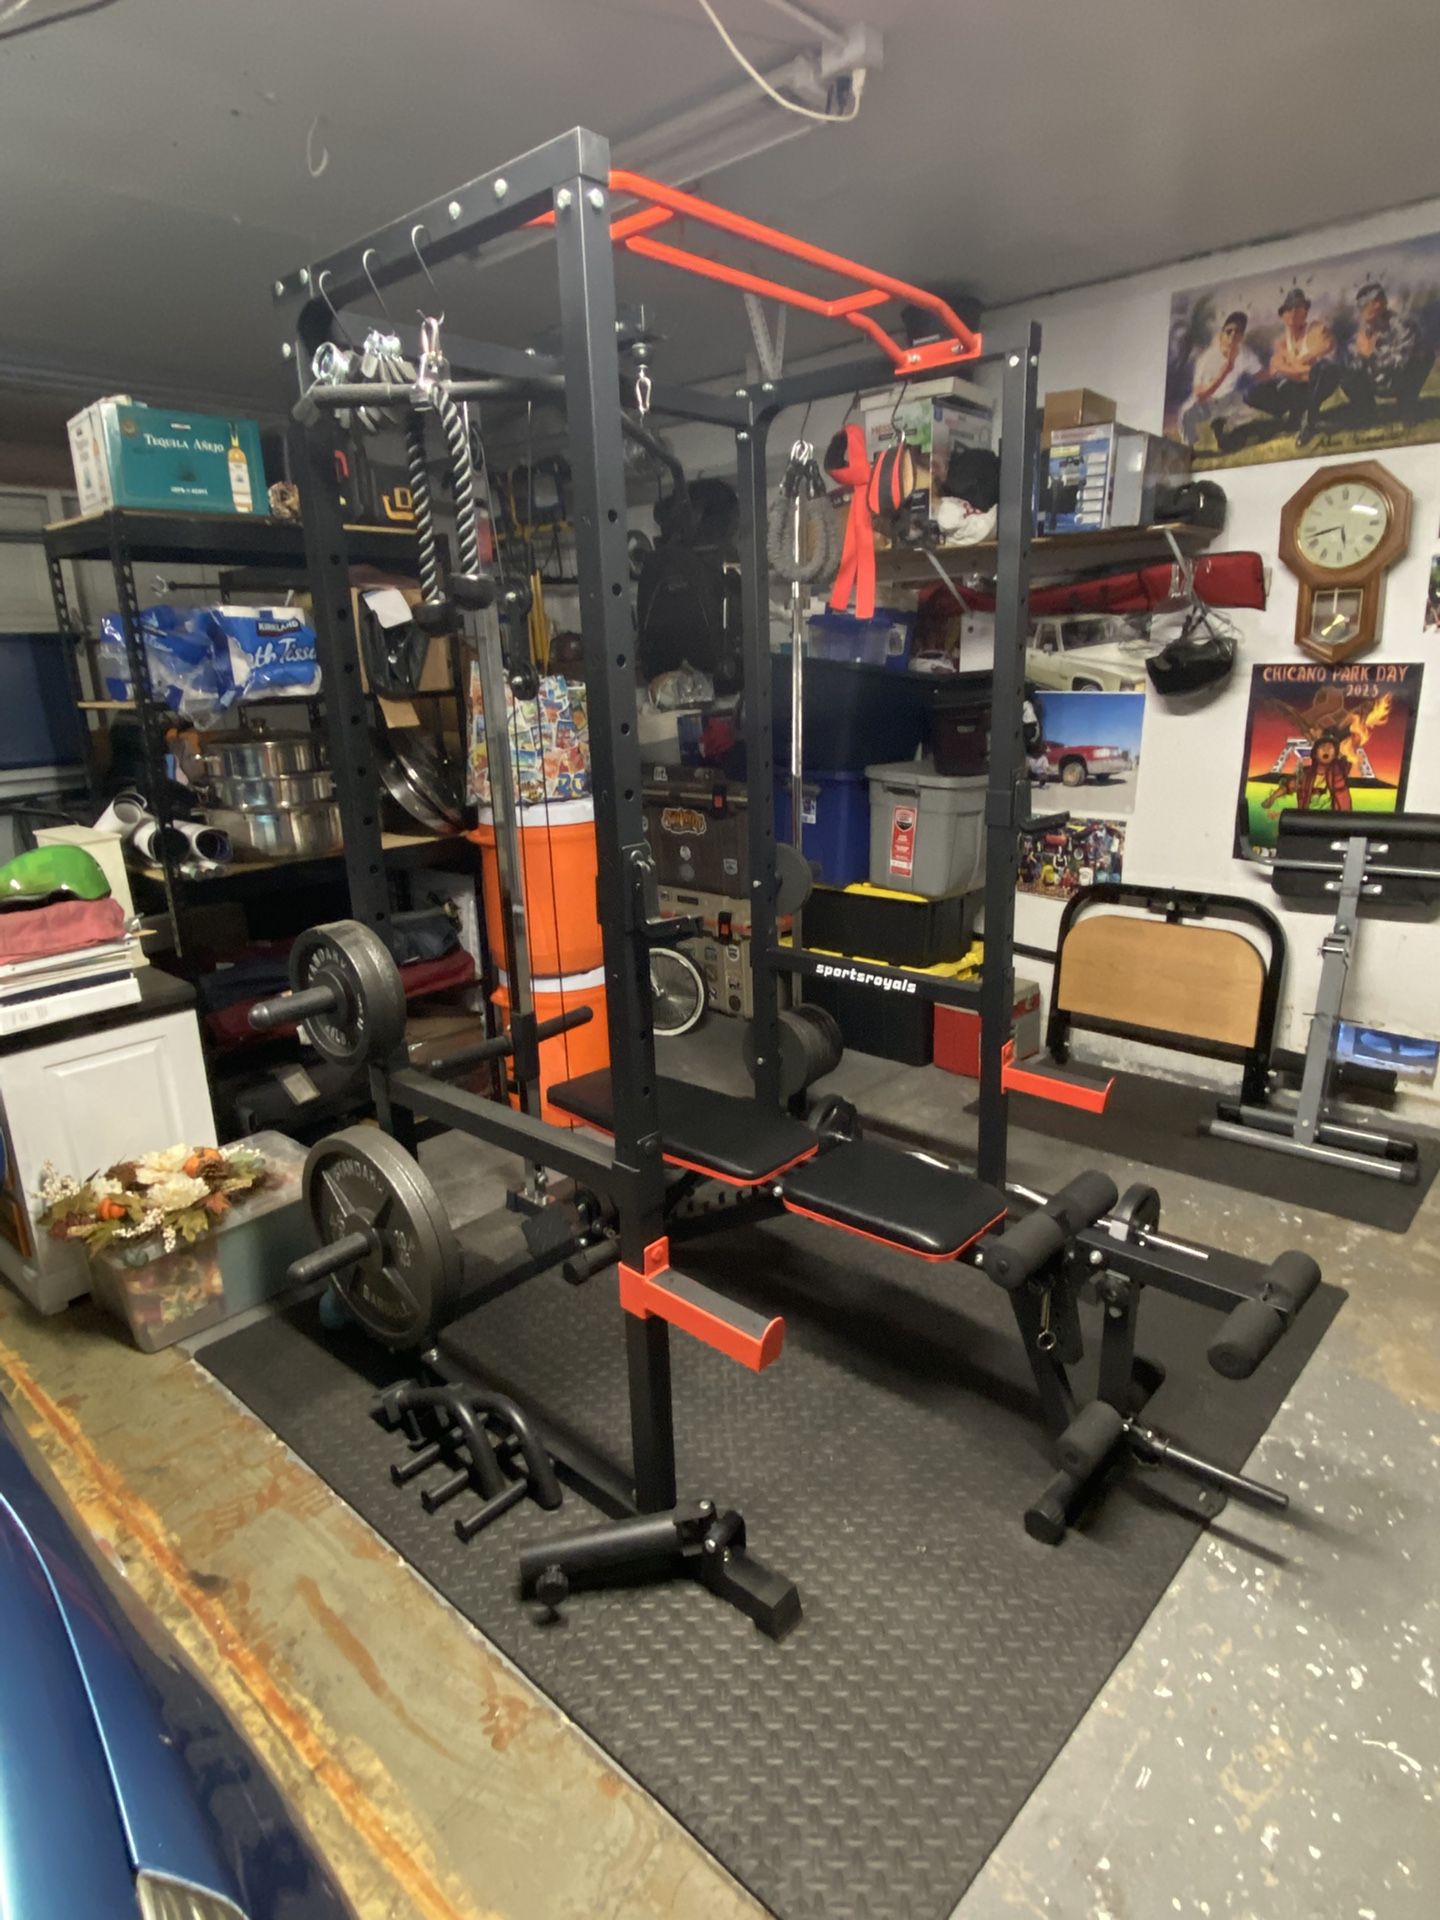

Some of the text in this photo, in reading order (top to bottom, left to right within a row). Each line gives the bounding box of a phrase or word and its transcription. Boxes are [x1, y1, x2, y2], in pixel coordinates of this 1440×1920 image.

[258, 620, 299, 633] KIRKLAND
[1263, 665, 1409, 683] CHICANO PARK DAY
[816, 963, 916, 994] sportsroyals
